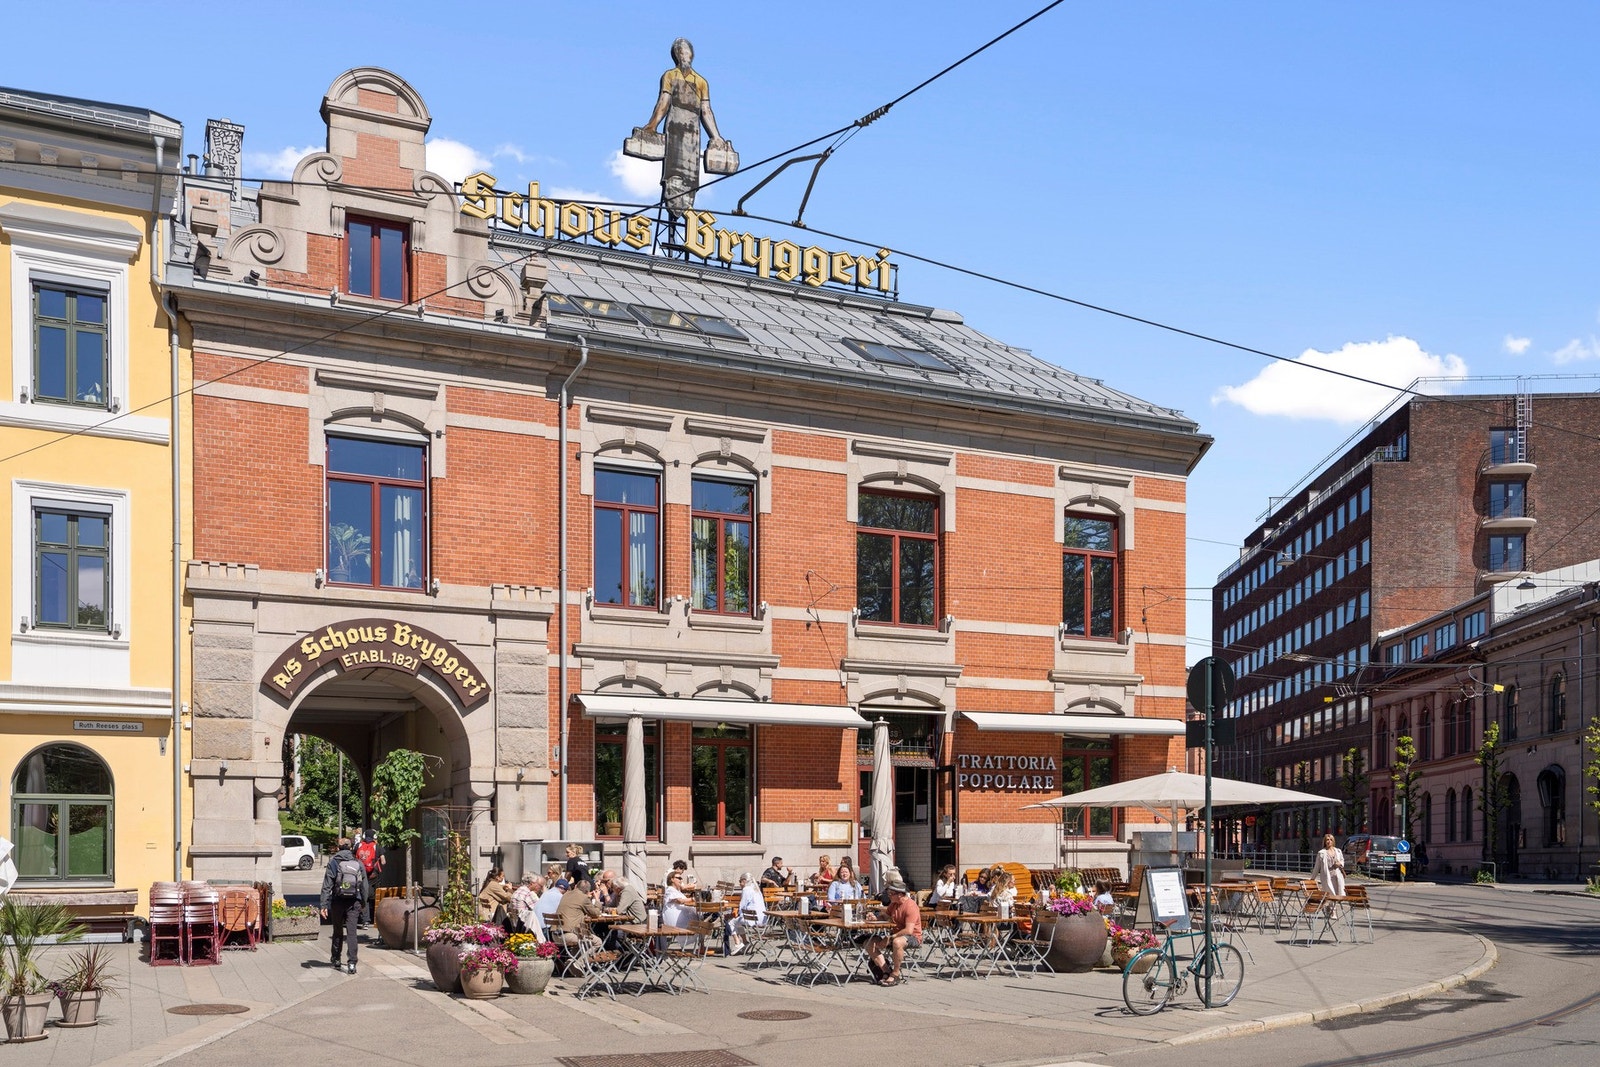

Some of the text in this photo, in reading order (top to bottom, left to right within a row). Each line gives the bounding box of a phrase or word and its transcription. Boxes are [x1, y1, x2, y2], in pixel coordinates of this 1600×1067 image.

[459, 170, 892, 292] Schous Bryggeri
[272, 622, 487, 698] A/S Schous Bryggeri
[958, 754, 1057, 770] TRATTORIA
[958, 773, 1054, 789] POPOLARE
